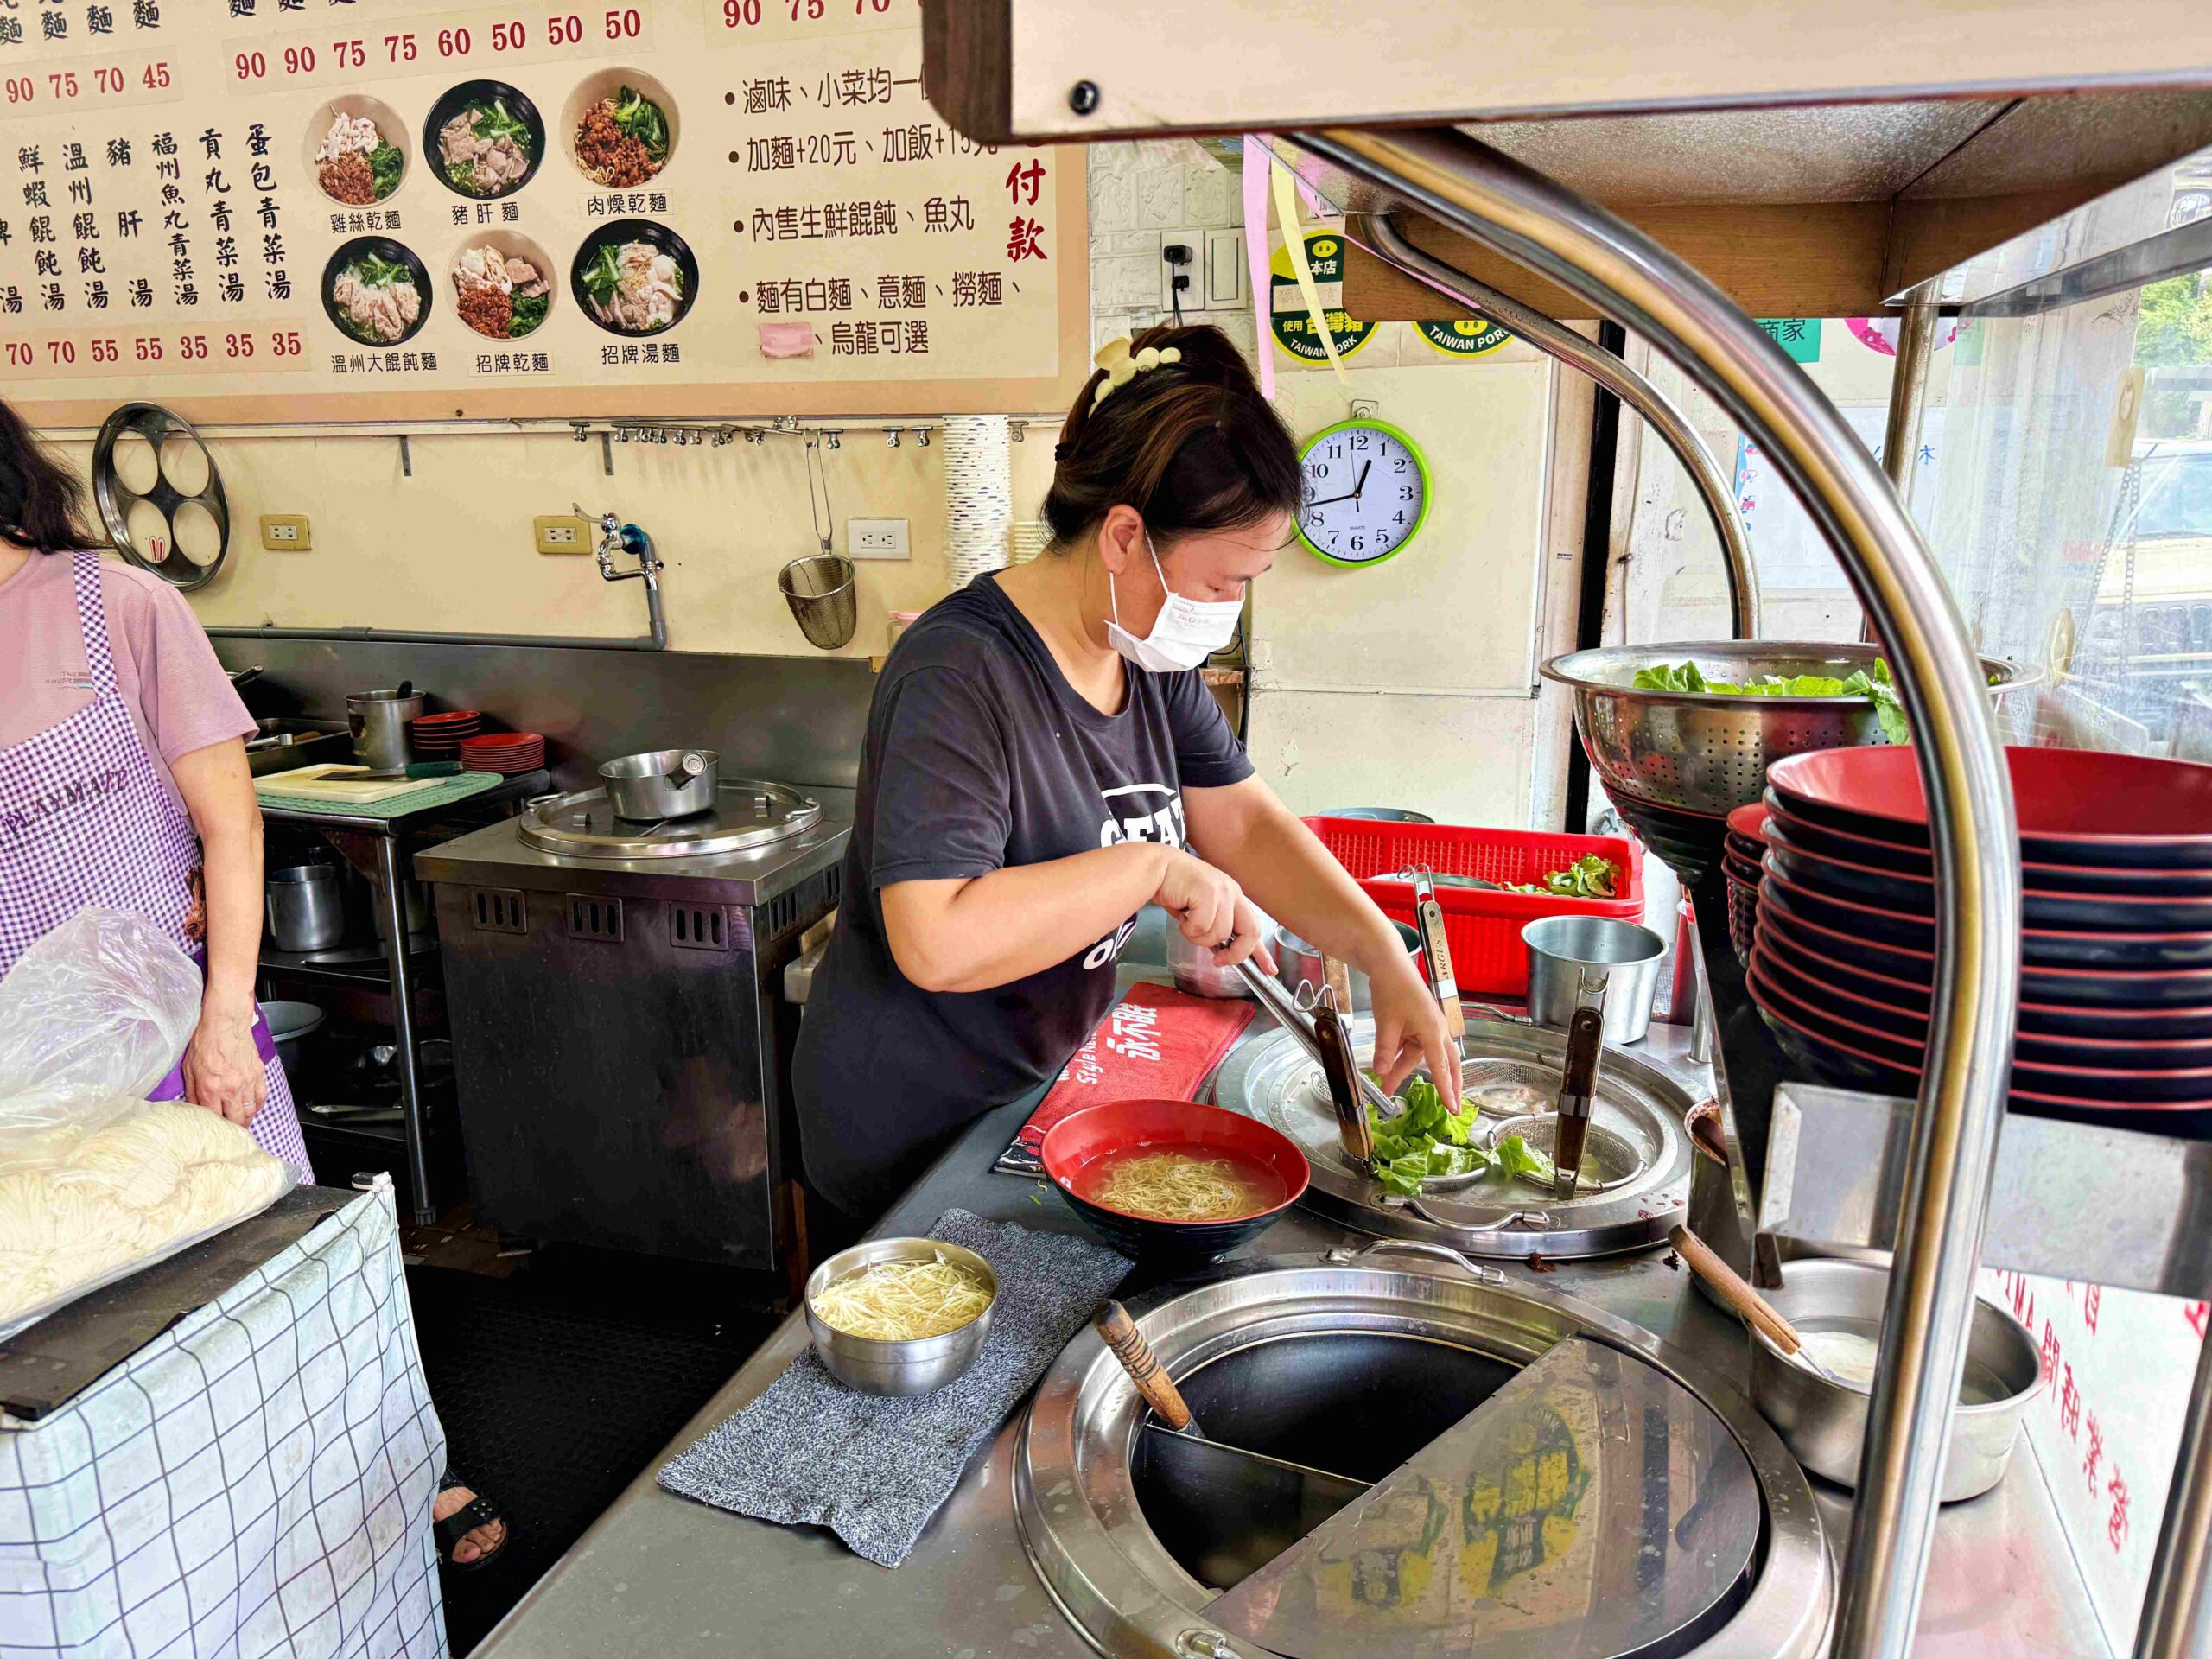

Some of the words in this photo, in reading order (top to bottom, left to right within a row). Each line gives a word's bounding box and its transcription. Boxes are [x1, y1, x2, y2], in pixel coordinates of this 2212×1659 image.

[0, 0, 24, 44] 麵
[723, 0, 761, 28] 90
[236, 52, 265, 79] 90
[284, 46, 315, 73] 90
[334, 40, 365, 68] 75
[385, 34, 417, 62] 75
[438, 28, 471, 57] 60
[493, 22, 525, 51] 50
[548, 15, 582, 45] 50
[606, 9, 640, 40] 50
[6, 77, 34, 103] 90
[49, 73, 78, 99] 75
[94, 67, 124, 93] 70
[143, 62, 170, 89] 45
[742, 62, 925, 115] 滷味、小菜均一
[245, 124, 292, 301] 蛋包青菜湯
[587, 193, 668, 216] 肉燥乾麵
[1006, 143, 1048, 263] 付款
[62, 143, 109, 309] 溫州餛飩湯
[106, 137, 154, 308] 豬肝湯
[152, 132, 199, 305] 福州魚丸青菜湯
[198, 128, 245, 302] 貢丸青菜湯
[329, 210, 402, 235] 雞絲乾麵
[18, 145, 65, 312] 鮮蝦餛飩湯
[1310, 260, 1337, 275] 本店
[1282, 321, 1302, 333] 使用
[1429, 326, 1474, 350] TAIWAN
[6, 343, 33, 365] 70
[48, 340, 76, 364] 70
[91, 338, 119, 363] 55
[135, 336, 163, 361] 55
[180, 335, 209, 359] 35
[226, 334, 255, 358] 35
[272, 332, 302, 356] 35
[601, 343, 681, 365] 招牌湯麵
[1290, 338, 1327, 357] TAIWAN
[1336, 335, 1357, 353] ORK
[331, 352, 438, 373] 溫州大餛飩麵
[475, 354, 550, 373] 招牌乾麵
[1327, 444, 1343, 459] 11
[1349, 435, 1369, 450] 12
[1379, 442, 1386, 456] 1
[1310, 464, 1328, 478] 10
[1394, 459, 1406, 473] 2
[1399, 486, 1414, 501] 3
[1311, 512, 1324, 526] 8
[1392, 510, 1405, 524] 4
[1328, 531, 1339, 544] 7
[1351, 536, 1363, 550] 6
[1376, 529, 1389, 543] 5
[1434, 939, 1449, 979] ARGUS
[1074, 1054, 1103, 1084] Style
